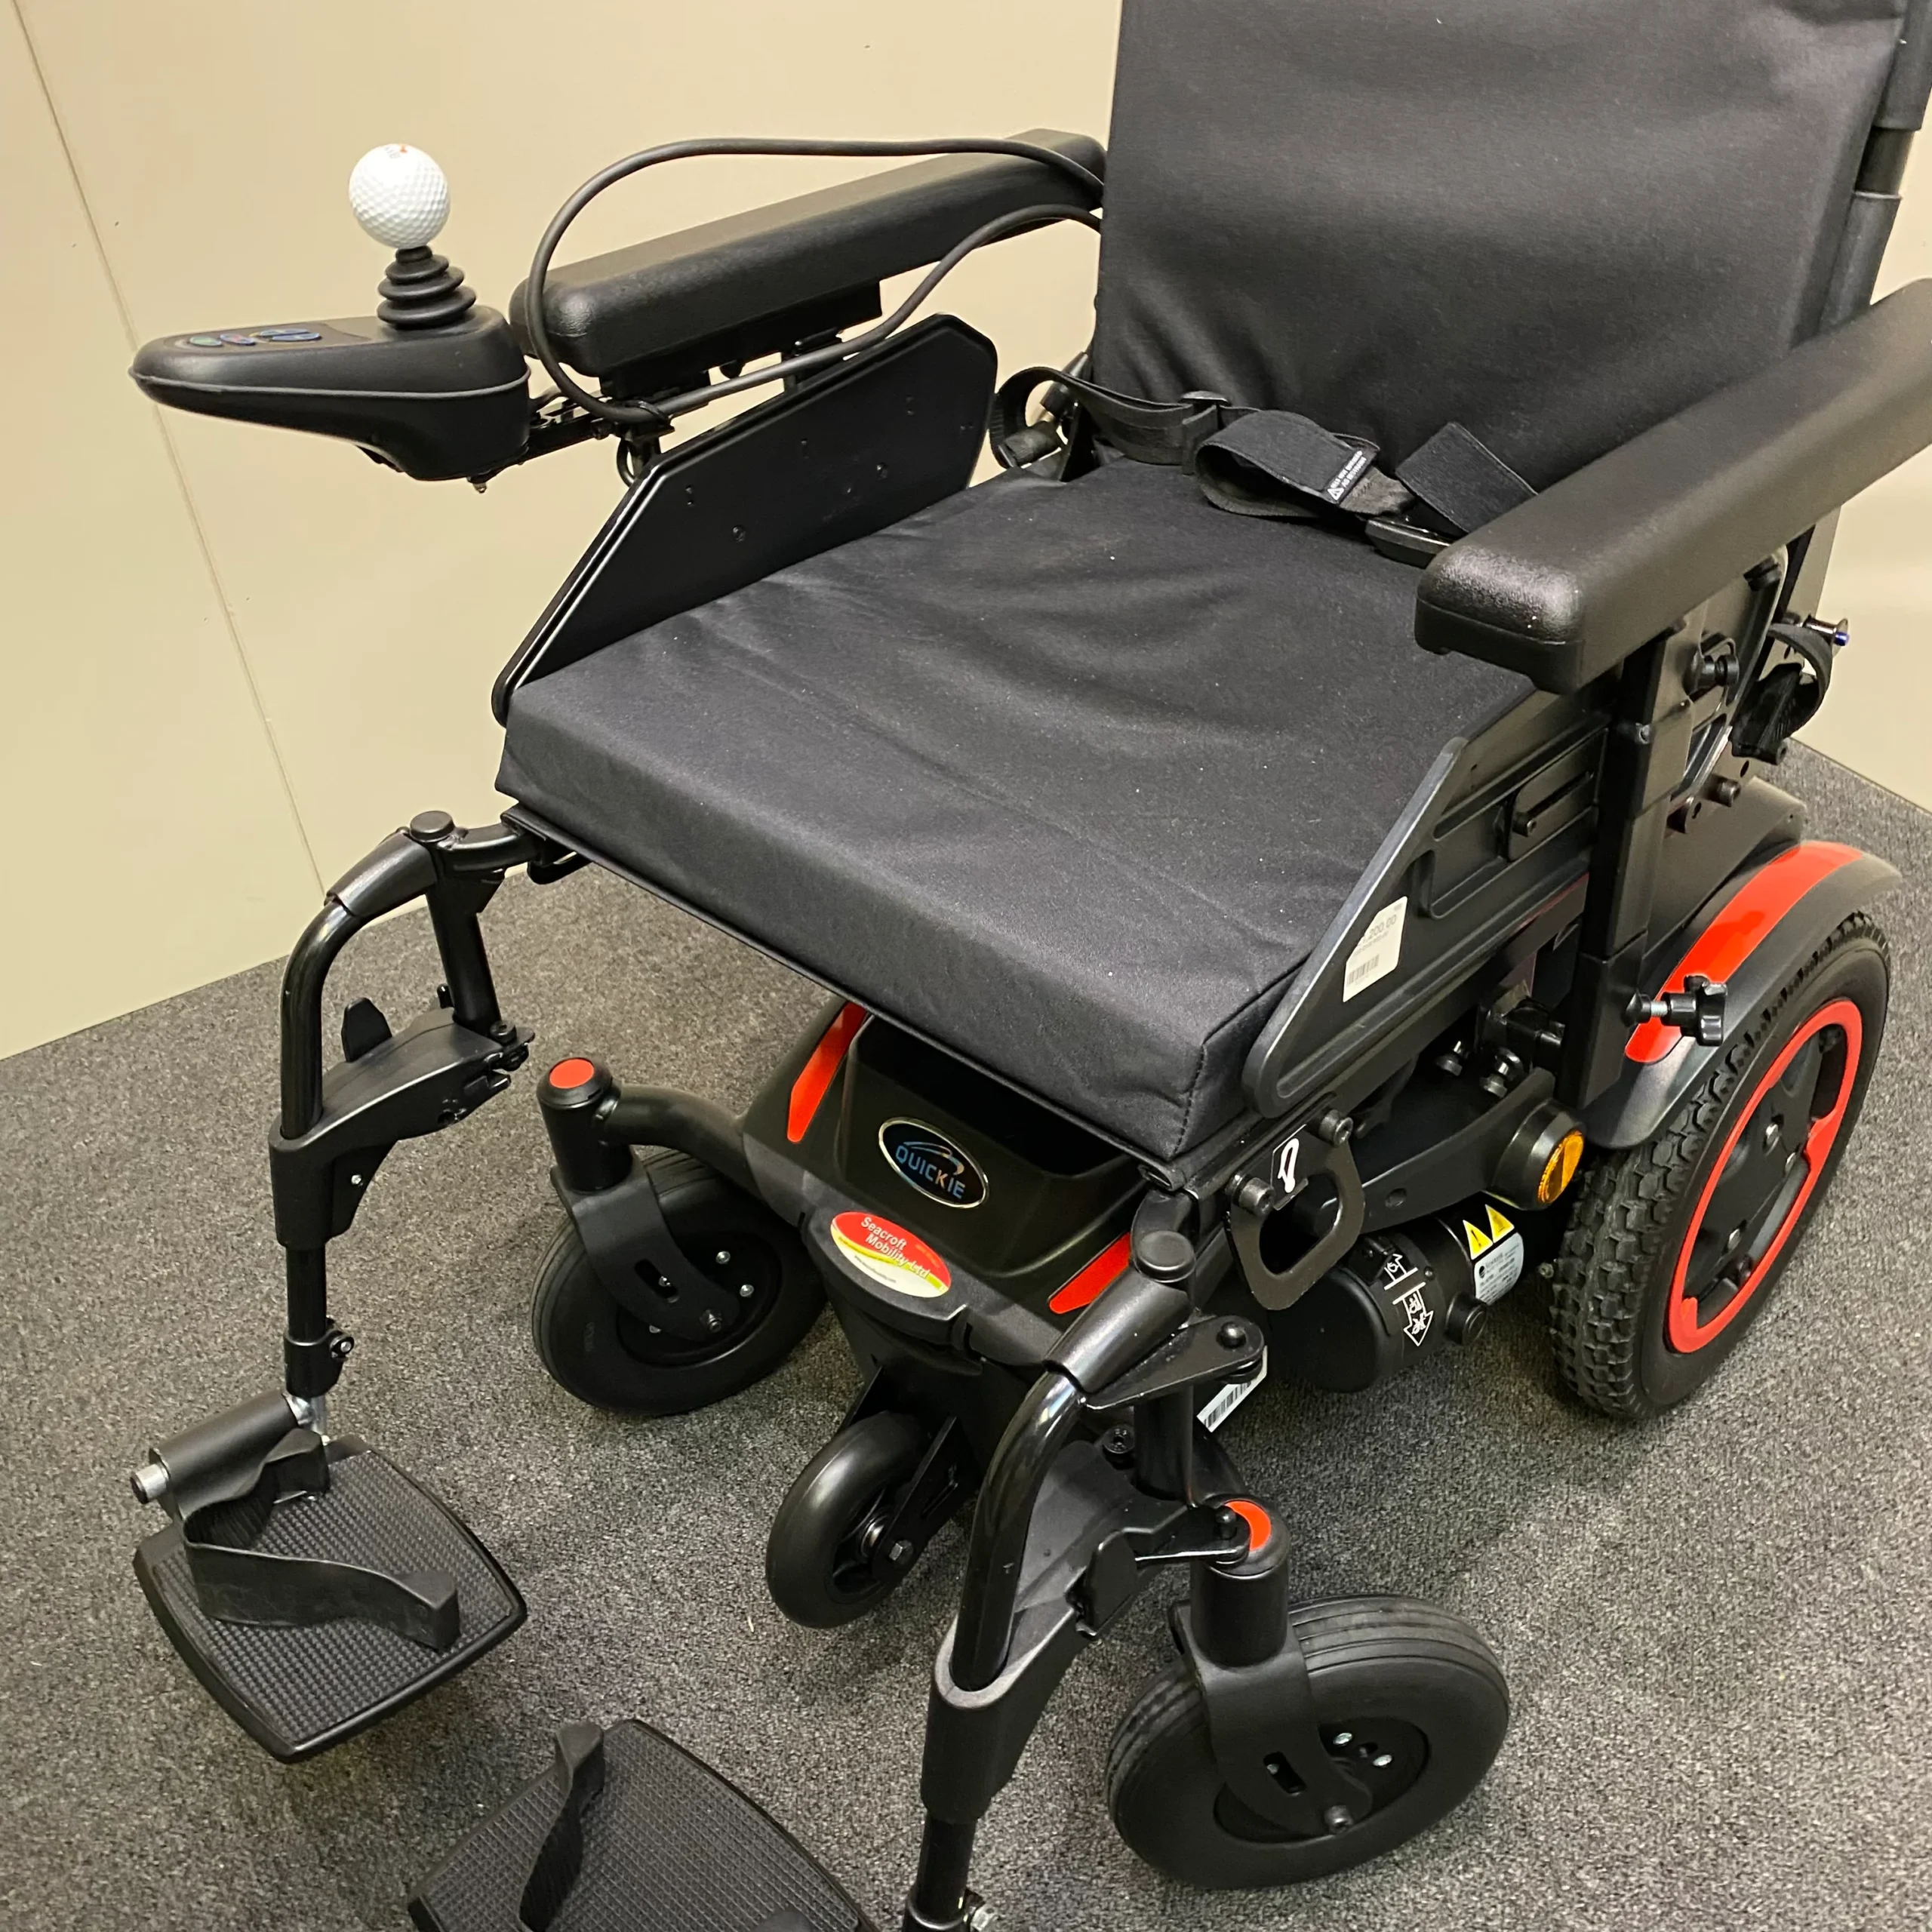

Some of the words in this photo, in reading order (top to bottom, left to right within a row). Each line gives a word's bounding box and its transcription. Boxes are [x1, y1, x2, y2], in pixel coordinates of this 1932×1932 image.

[895, 1145, 966, 1199] QUICKIE
[860, 1217, 907, 1251] Seacroft
[865, 1233, 909, 1267] Mobility
[909, 1260, 931, 1279] Ltd
